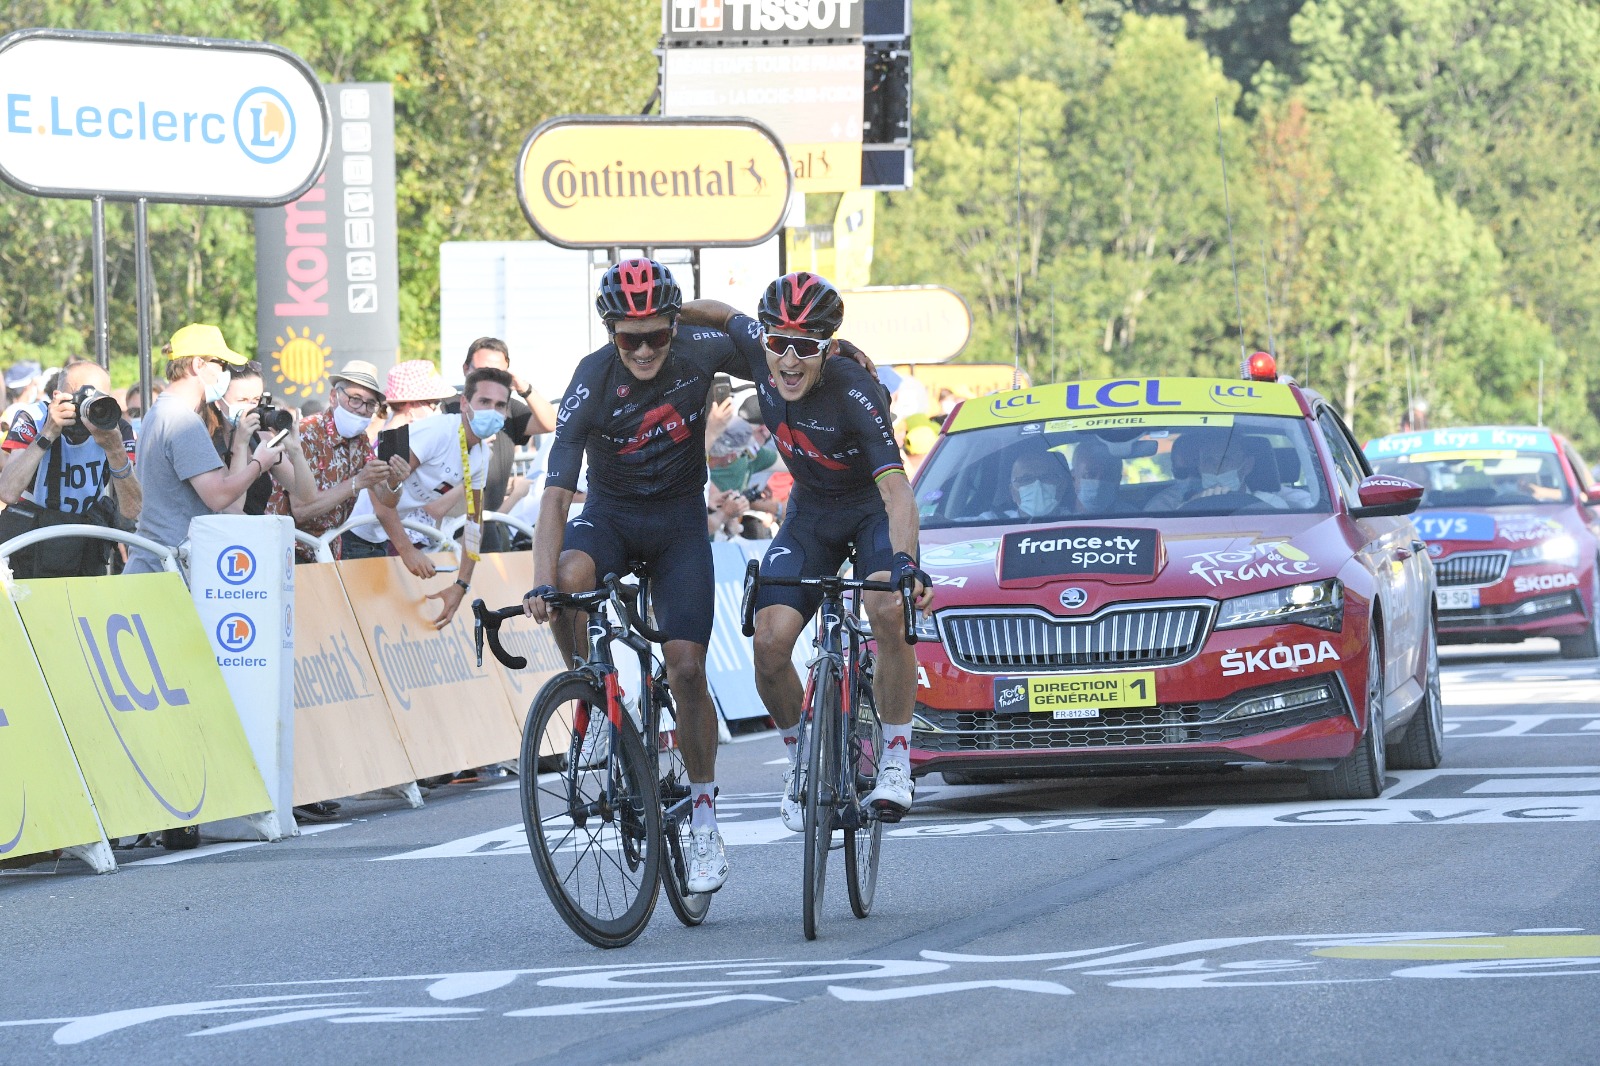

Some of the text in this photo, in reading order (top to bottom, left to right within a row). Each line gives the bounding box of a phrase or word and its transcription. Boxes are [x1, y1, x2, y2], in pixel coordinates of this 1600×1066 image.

[725, 0, 859, 31] TISSOT
[6, 93, 226, 145] E.Leclerc
[542, 158, 735, 209] Continental
[274, 172, 329, 317] kom
[692, 331, 730, 341] GREN
[1065, 379, 1182, 410] LCL
[1214, 384, 1263, 399] LCL
[555, 382, 591, 439] INEOS
[994, 394, 1041, 410] LCL
[848, 388, 894, 447] GRENADIER
[1085, 416, 1146, 427] OFFICIEL
[1378, 435, 1423, 453] Krys
[1433, 430, 1480, 448] Krys
[1491, 429, 1538, 448] Krys
[1070, 550, 1138, 568] sport
[205, 588, 268, 600] E.Leclerc
[1437, 591, 1469, 604] 9-SQ
[78, 612, 191, 712] LCL
[216, 655, 267, 667] Leclerc
[373, 620, 475, 711] Continental
[1219, 640, 1341, 677] ŠKODA
[294, 634, 359, 709] nental
[1033, 678, 1147, 700] DIRECTION 1
[1034, 691, 1118, 705] GÉNÉRALE
[1055, 709, 1096, 719] FR-812-SQ
